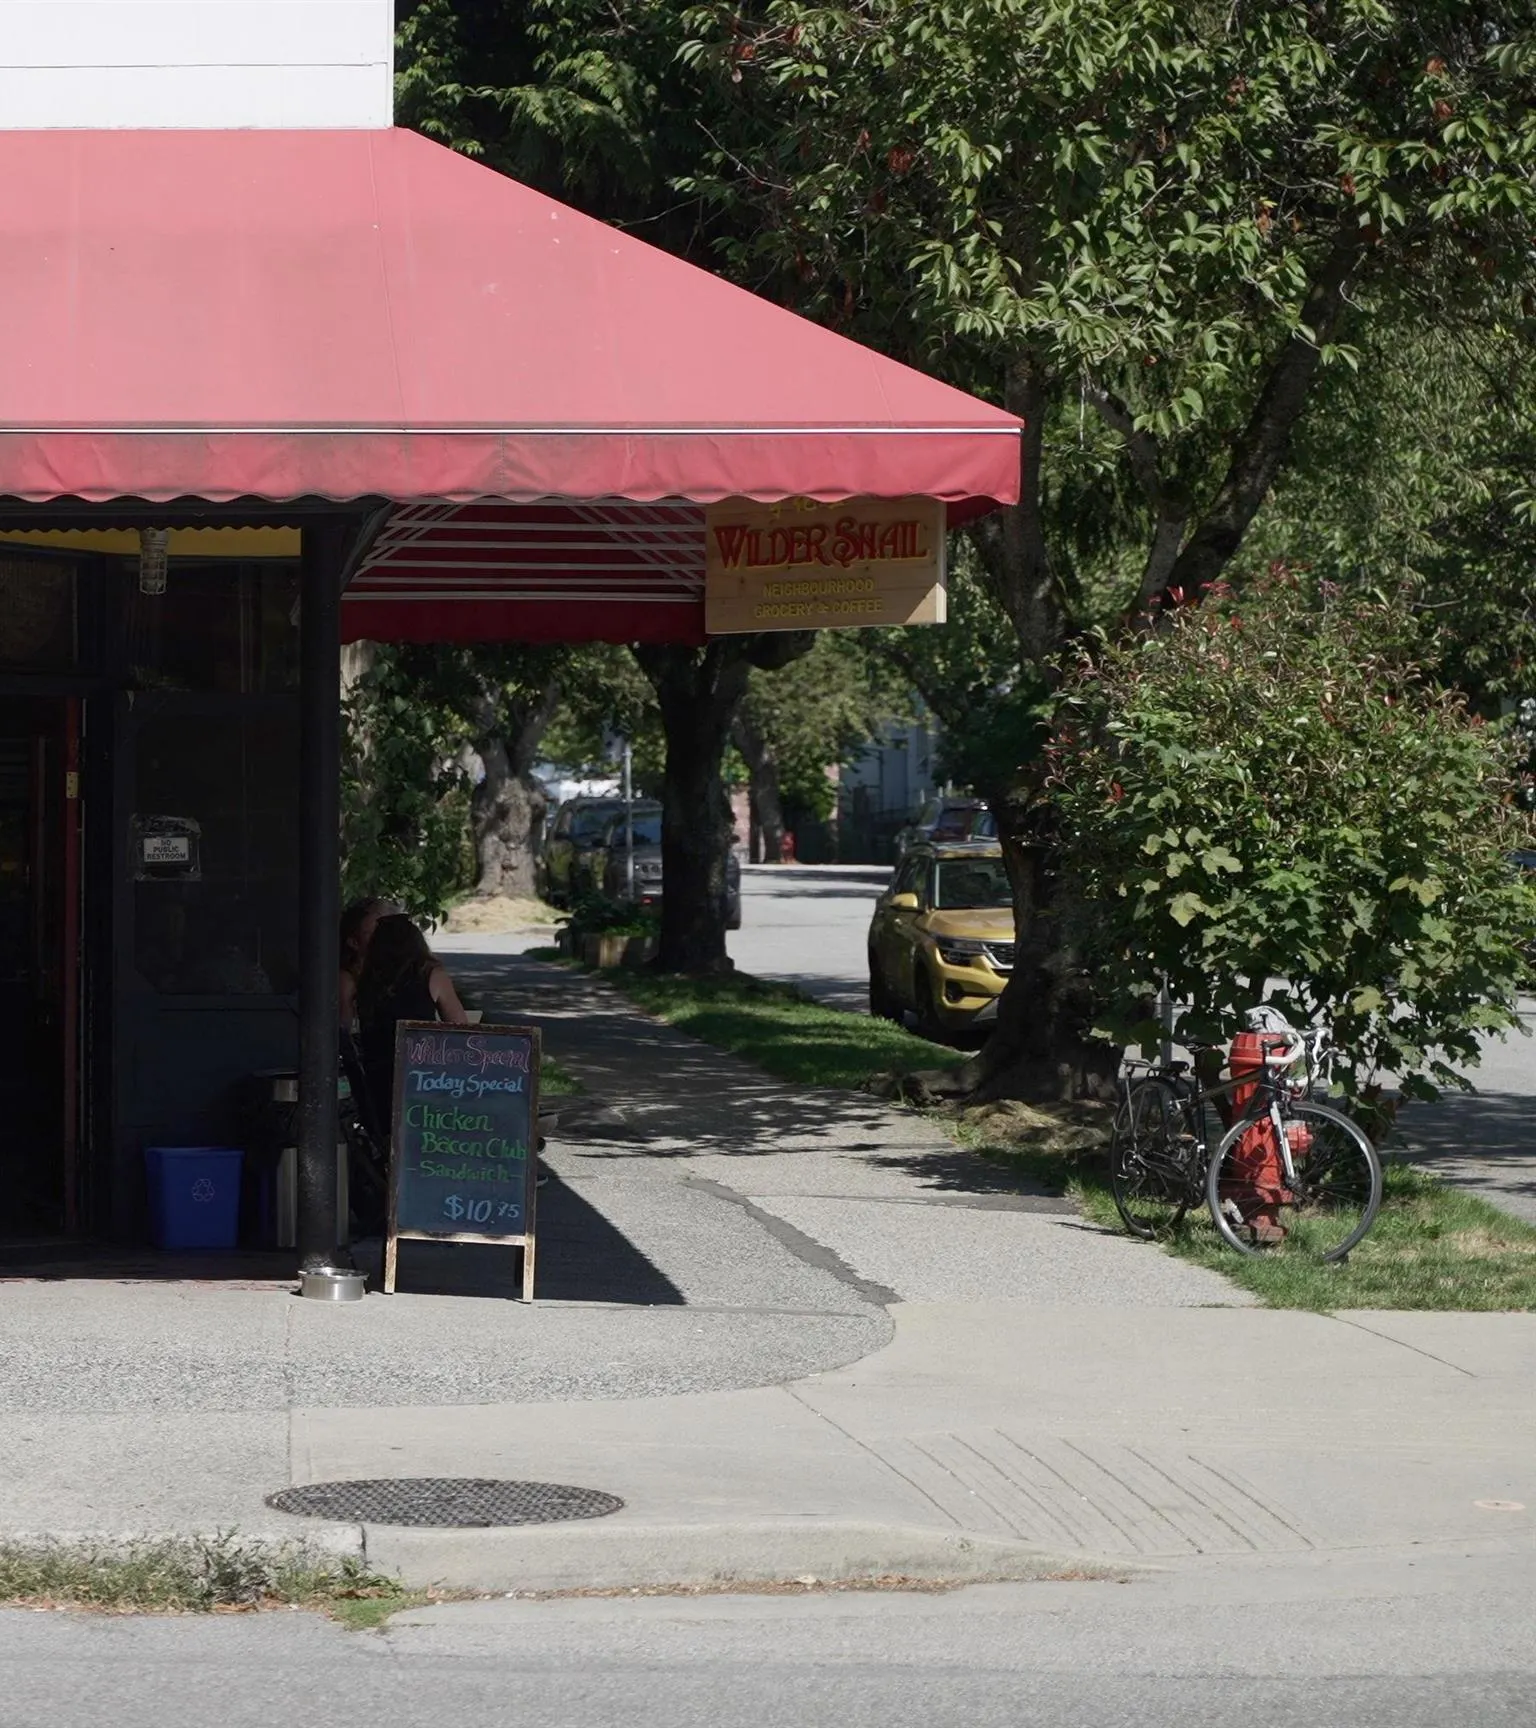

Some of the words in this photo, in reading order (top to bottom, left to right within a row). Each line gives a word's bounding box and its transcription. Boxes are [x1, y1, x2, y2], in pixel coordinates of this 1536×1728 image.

[713, 524, 830, 568] WILDER
[831, 516, 929, 569] SNAIL
[764, 578, 875, 597] NEIGHBOURHOOD
[755, 602, 812, 618] GROCERY
[833, 599, 883, 614] COFFEE
[146, 852, 185, 860] RESTROOM
[409, 1070, 465, 1098] Today
[466, 1074, 524, 1098] Special
[406, 1104, 494, 1132] Chicken
[421, 1131, 482, 1157] Bacon
[486, 1138, 527, 1160] Club
